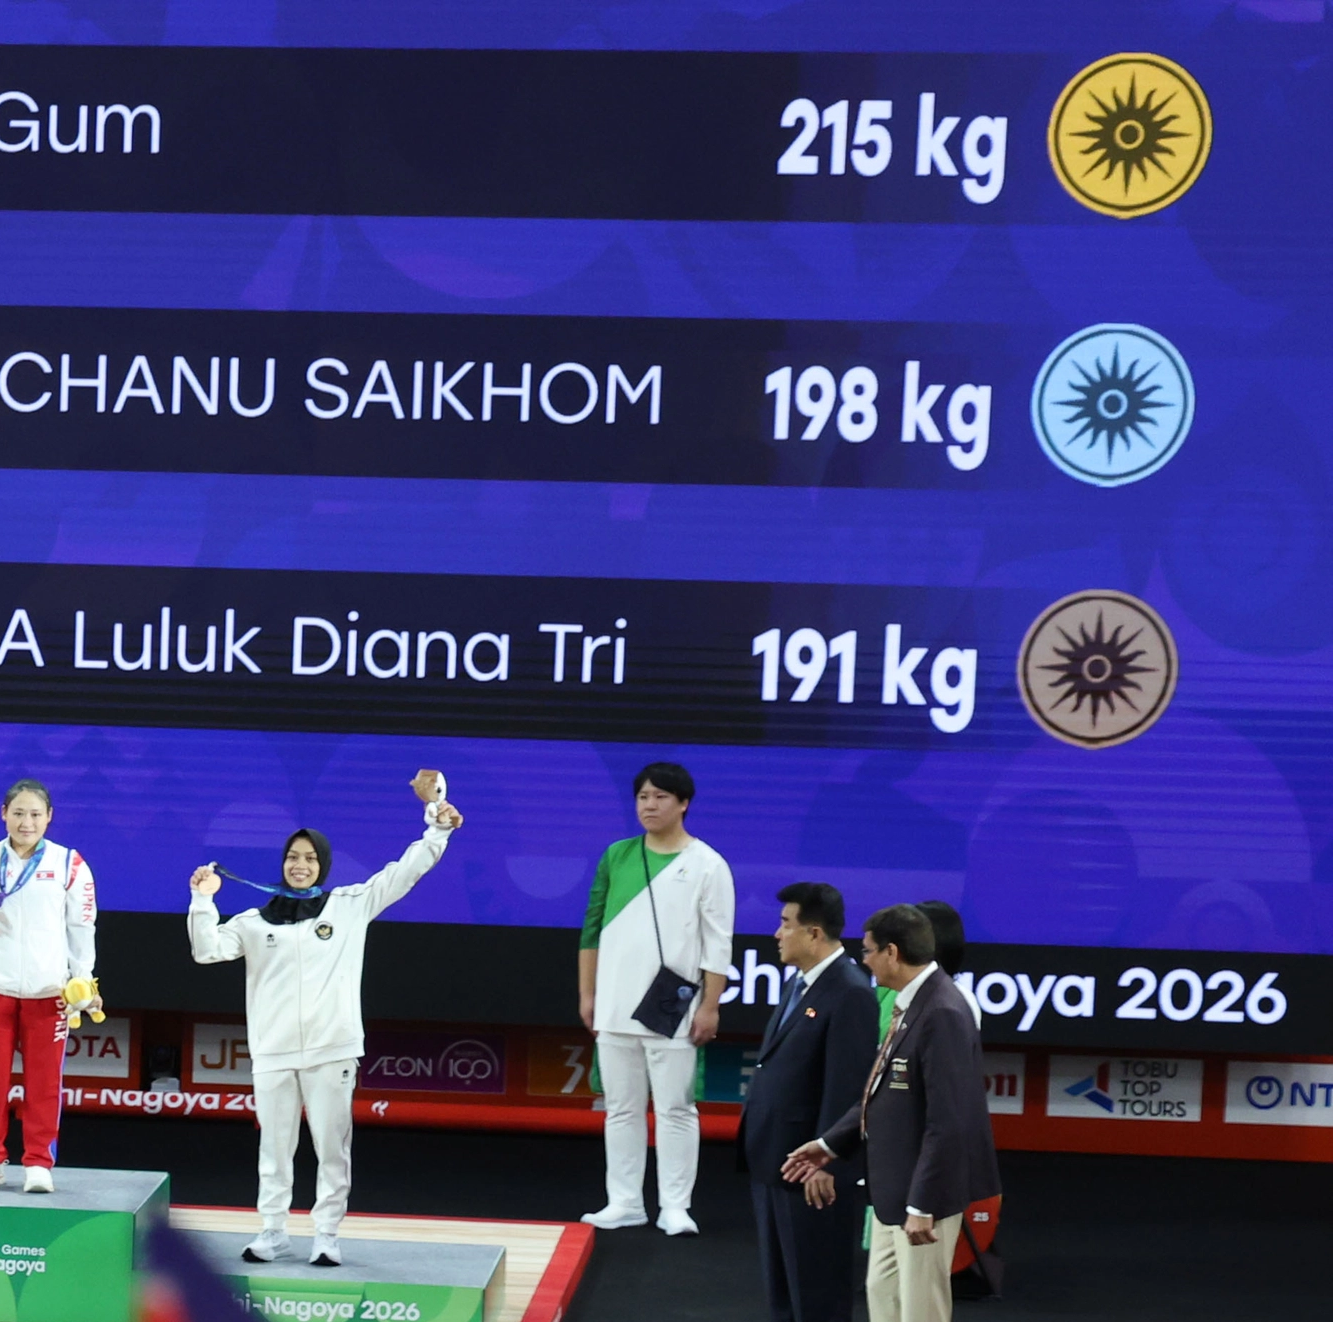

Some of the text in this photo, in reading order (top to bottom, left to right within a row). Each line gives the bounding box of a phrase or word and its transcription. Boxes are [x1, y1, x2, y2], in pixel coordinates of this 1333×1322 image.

[775, 98, 894, 177] 215
[915, 92, 1009, 204] kg
[303, 357, 664, 425] SAIKHOM
[763, 365, 880, 443] 198
[901, 360, 993, 471] kg
[73, 608, 263, 676] Luluk
[290, 611, 511, 684] Diana
[538, 617, 628, 685] Tri
[751, 626, 858, 703] 191
[881, 622, 979, 734] kg
[1115, 966, 1288, 1026] 2026
[1121, 1061, 1179, 1079] TOBU
[1121, 1080, 1162, 1097] TOP
[1120, 1099, 1188, 1117] TOURS
[1, 1244, 46, 1257] Games
[359, 1300, 421, 1322] 2026
